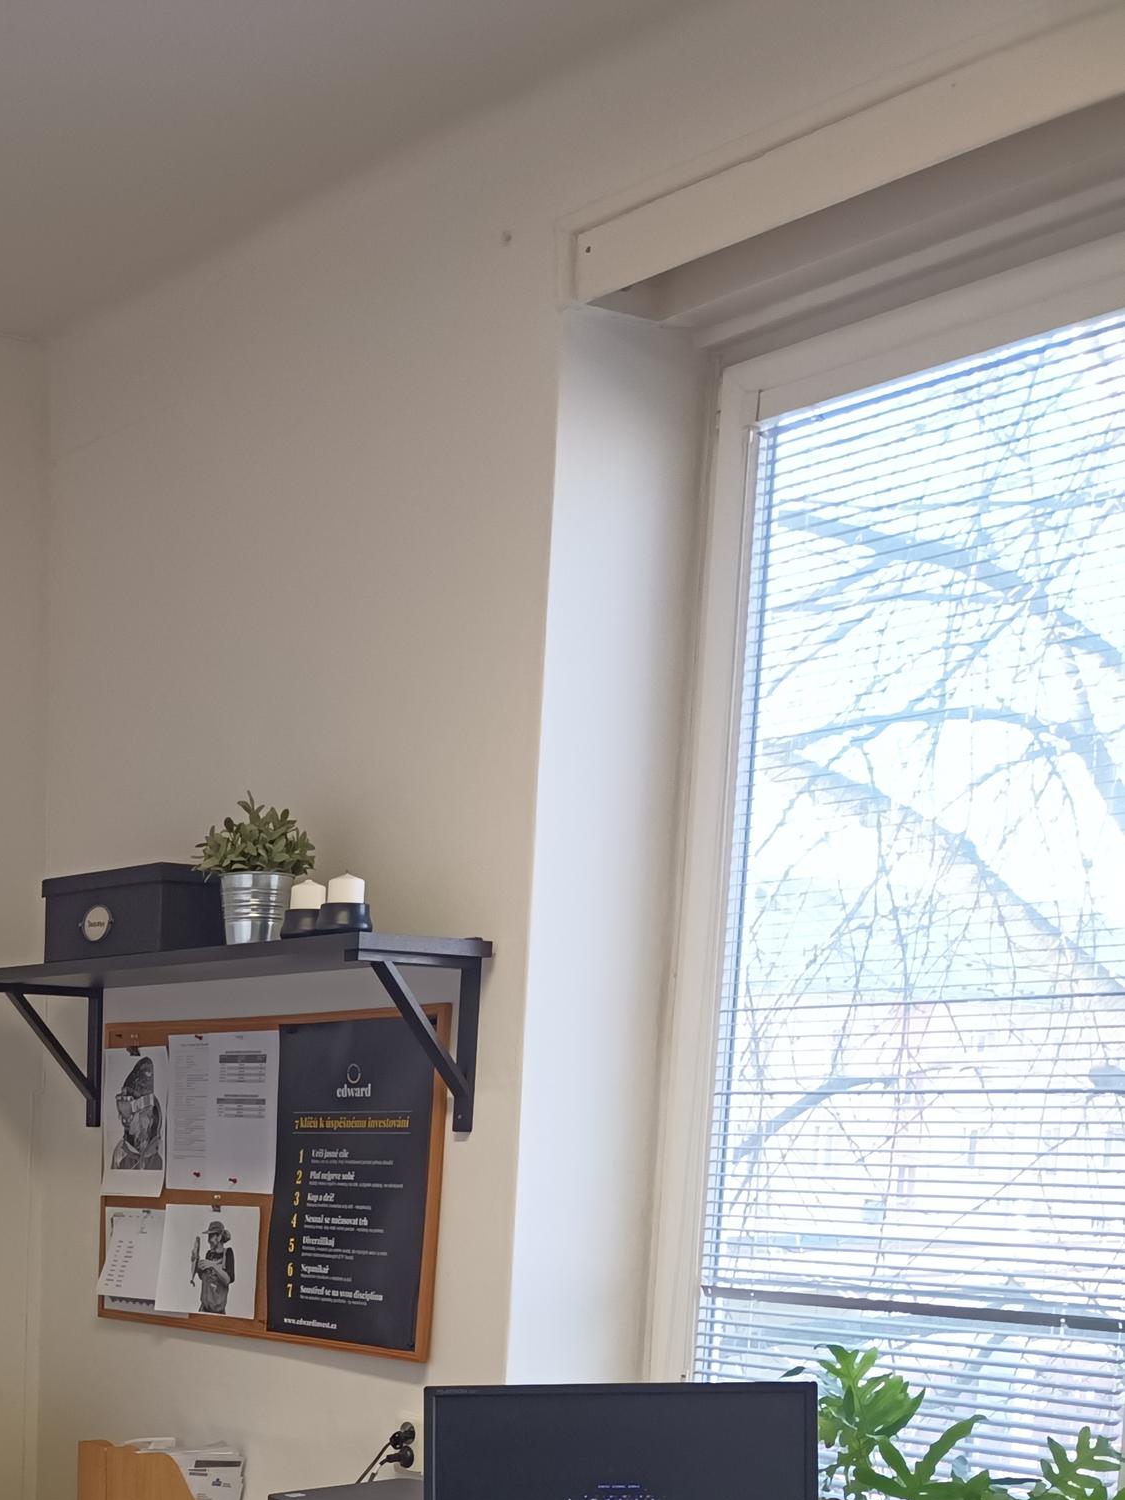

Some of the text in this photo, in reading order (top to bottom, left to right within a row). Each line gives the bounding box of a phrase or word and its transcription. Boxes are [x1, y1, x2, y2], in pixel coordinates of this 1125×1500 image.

[336, 1083, 372, 1098] edward
[295, 1120, 300, 1130] 7
[367, 1116, 409, 1128] investování
[298, 1149, 305, 1164] 1
[296, 1170, 303, 1185] 2
[293, 1191, 300, 1206] 3
[307, 1192, 319, 1203] Kup
[290, 1213, 297, 1228] 4
[358, 1216, 369, 1226] trh
[288, 1238, 295, 1252] 5
[287, 1262, 294, 1277] 6
[286, 1283, 293, 1298] 7
